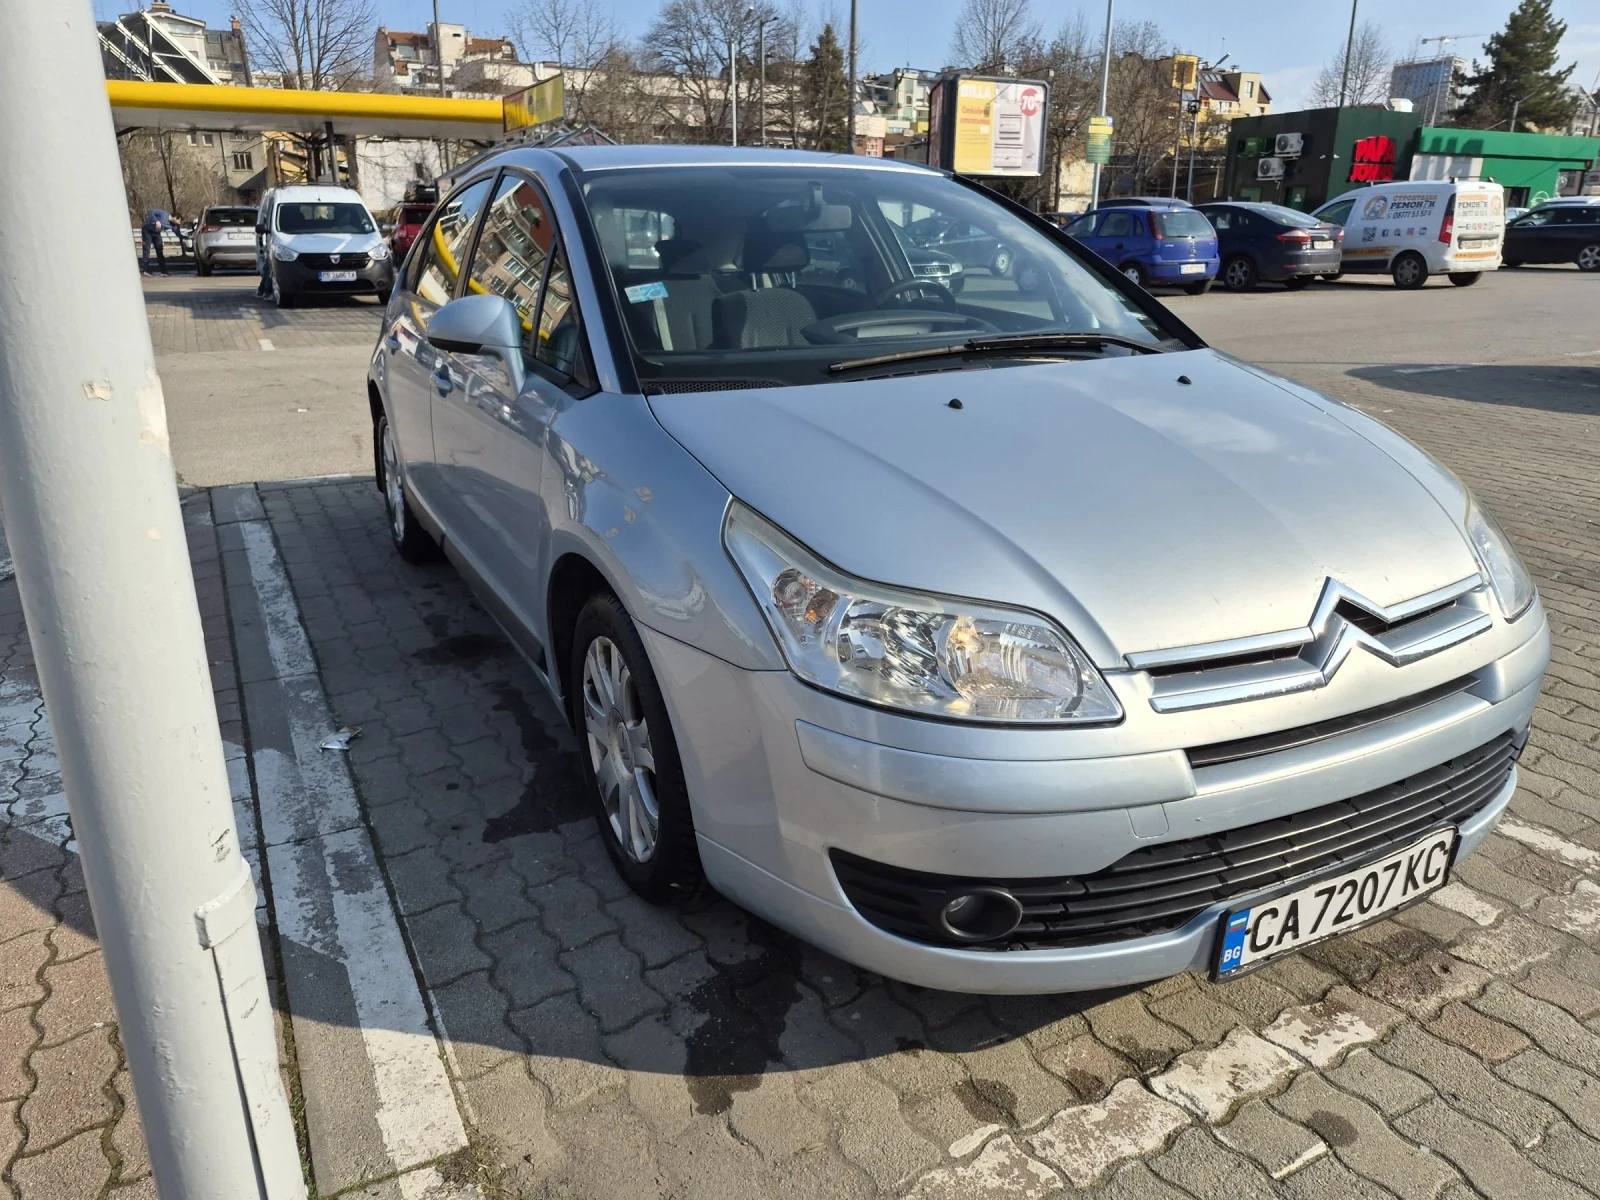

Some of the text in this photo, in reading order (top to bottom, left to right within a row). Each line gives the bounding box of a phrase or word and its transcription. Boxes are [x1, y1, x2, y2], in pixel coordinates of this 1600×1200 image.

[960, 84, 992, 98] BILLA
[1354, 135, 1396, 162] PAPA
[1250, 840, 1447, 953] CA 7207 KC
[1223, 946, 1241, 963] BG
